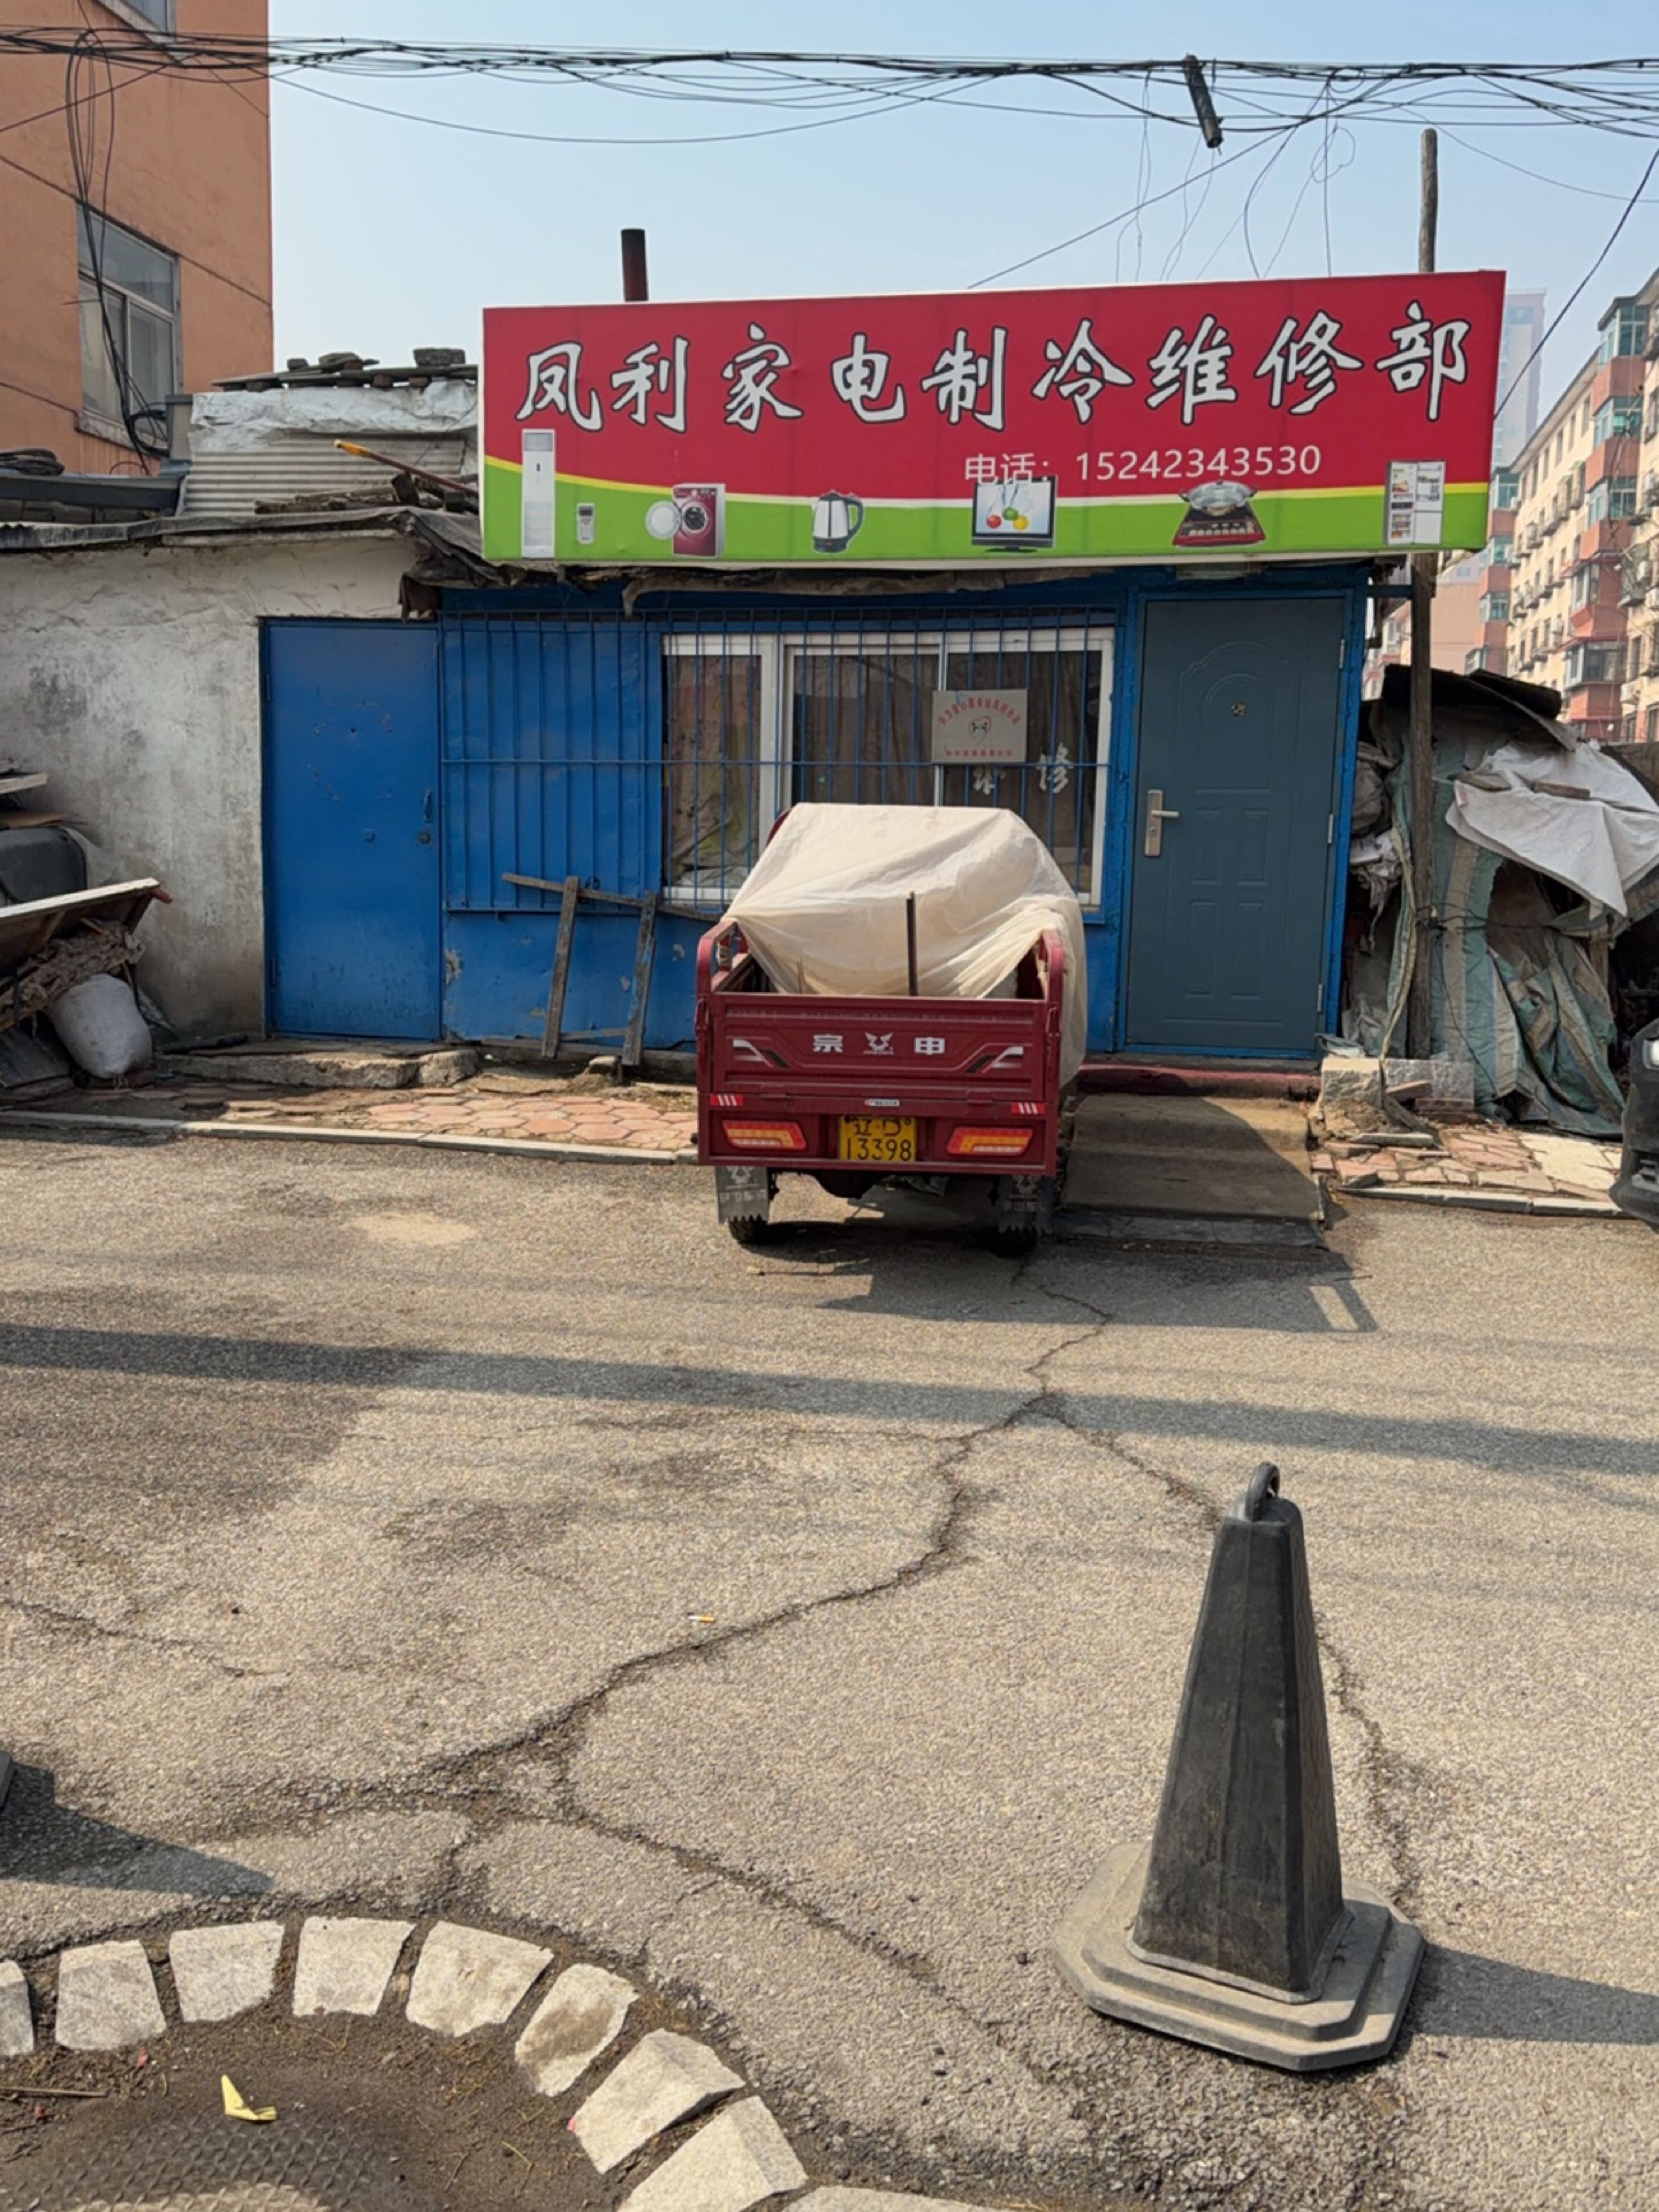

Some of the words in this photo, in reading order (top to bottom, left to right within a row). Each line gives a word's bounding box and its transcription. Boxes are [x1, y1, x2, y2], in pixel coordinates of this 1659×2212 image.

[516, 300, 1471, 434] 凤利家电制冷维修部
[1076, 445, 1322, 480] 15242343530
[847, 1138, 912, 1162] 13398
